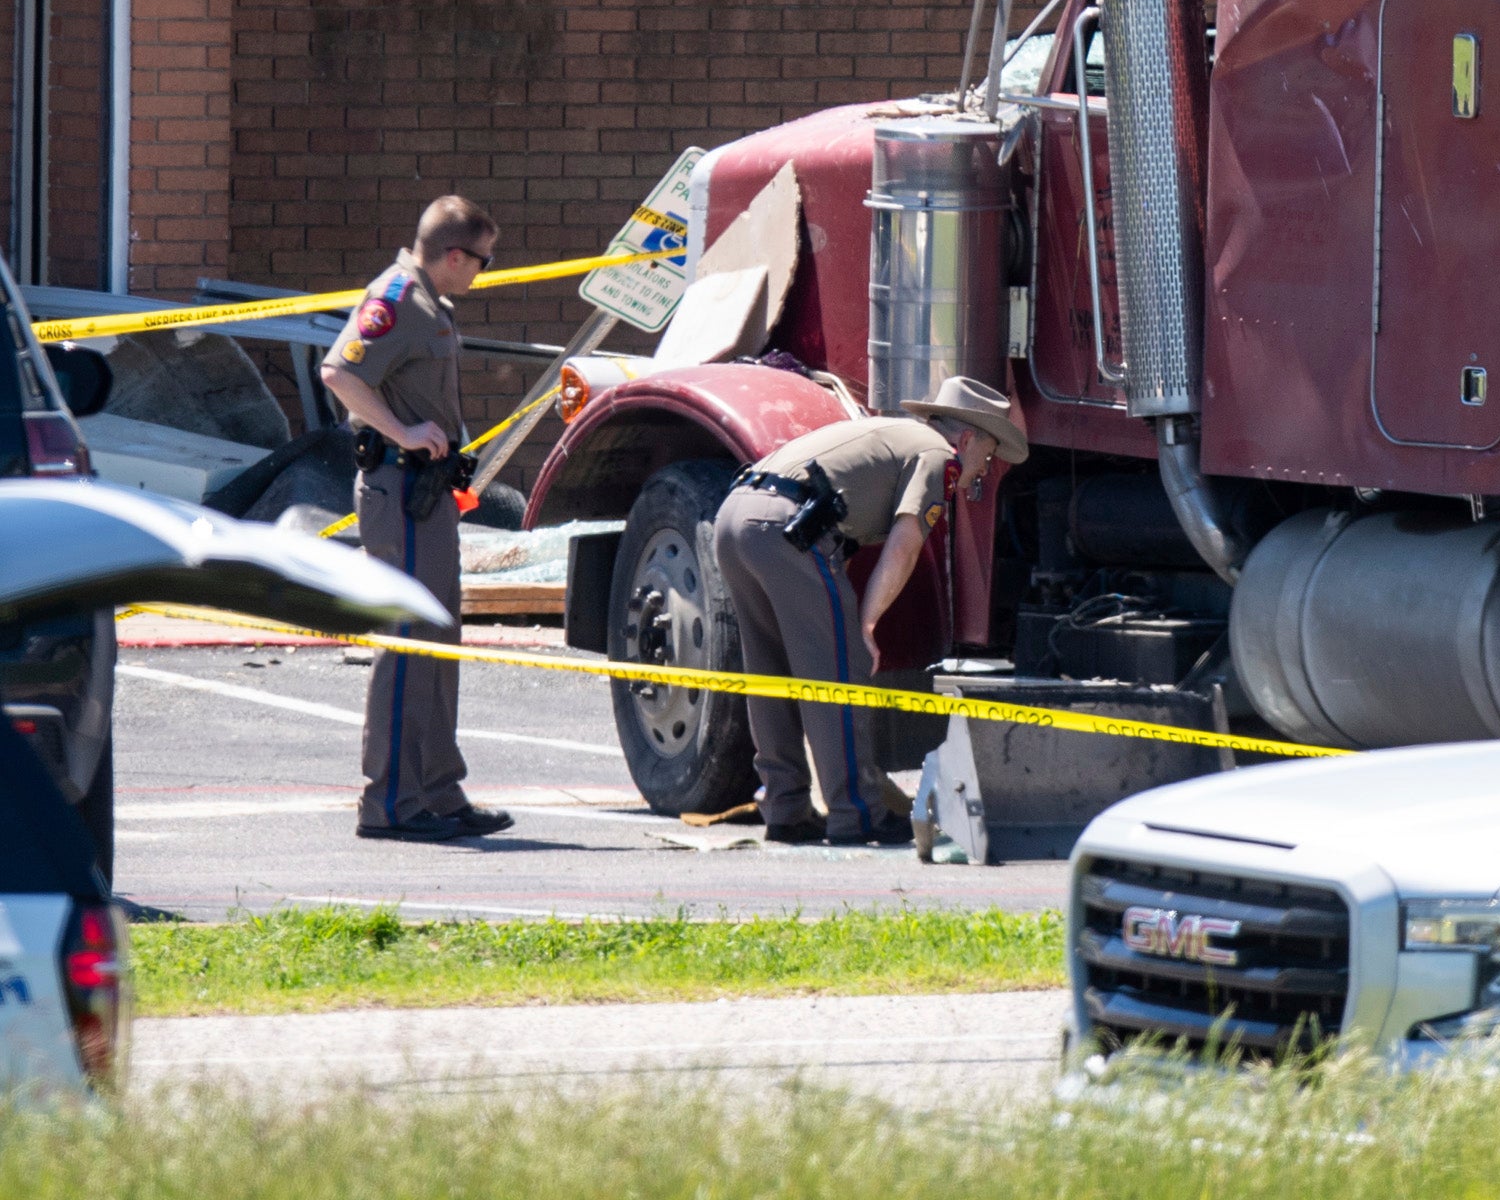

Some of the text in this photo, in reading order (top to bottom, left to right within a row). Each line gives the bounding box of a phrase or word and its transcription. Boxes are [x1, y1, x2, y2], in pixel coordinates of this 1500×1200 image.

[601, 285, 653, 316] AND TOWING
[38, 324, 73, 340] CROSS
[1123, 906, 1241, 966] GMC
